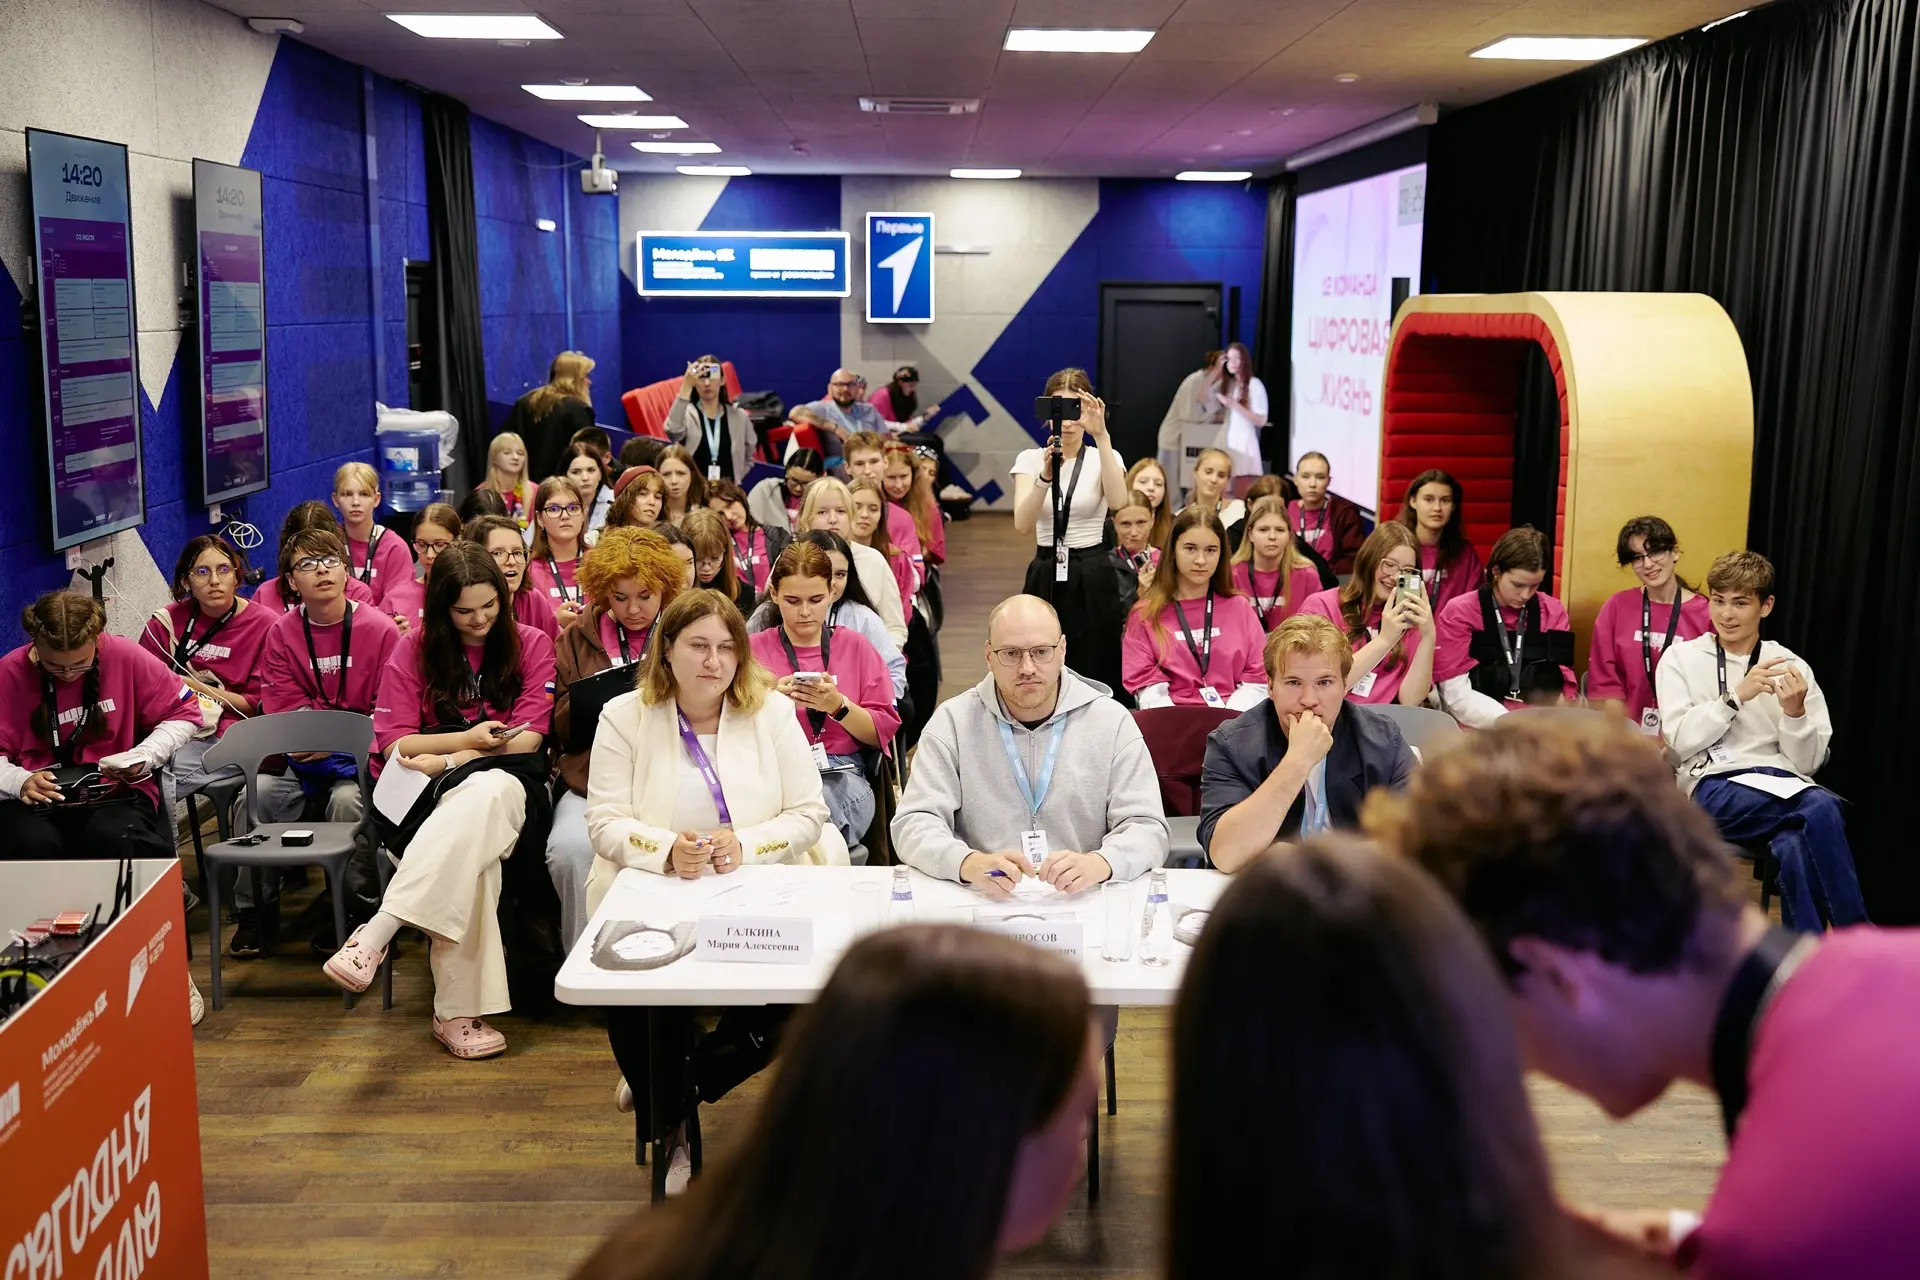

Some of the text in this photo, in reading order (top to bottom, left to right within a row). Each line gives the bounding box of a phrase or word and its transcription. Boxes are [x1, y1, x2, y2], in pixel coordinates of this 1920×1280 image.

[62, 162, 103, 188] 14:20
[65, 191, 102, 205] Движение
[216, 186, 245, 208] 14:20
[875, 220, 925, 237] Первые
[1320, 371, 1373, 416] ЖИЗНЬ
[726, 927, 781, 938] ГАЛКИНА
[707, 939, 800, 952] Мария Алексеевна
[42, 1010, 95, 1071] Молодёжь
